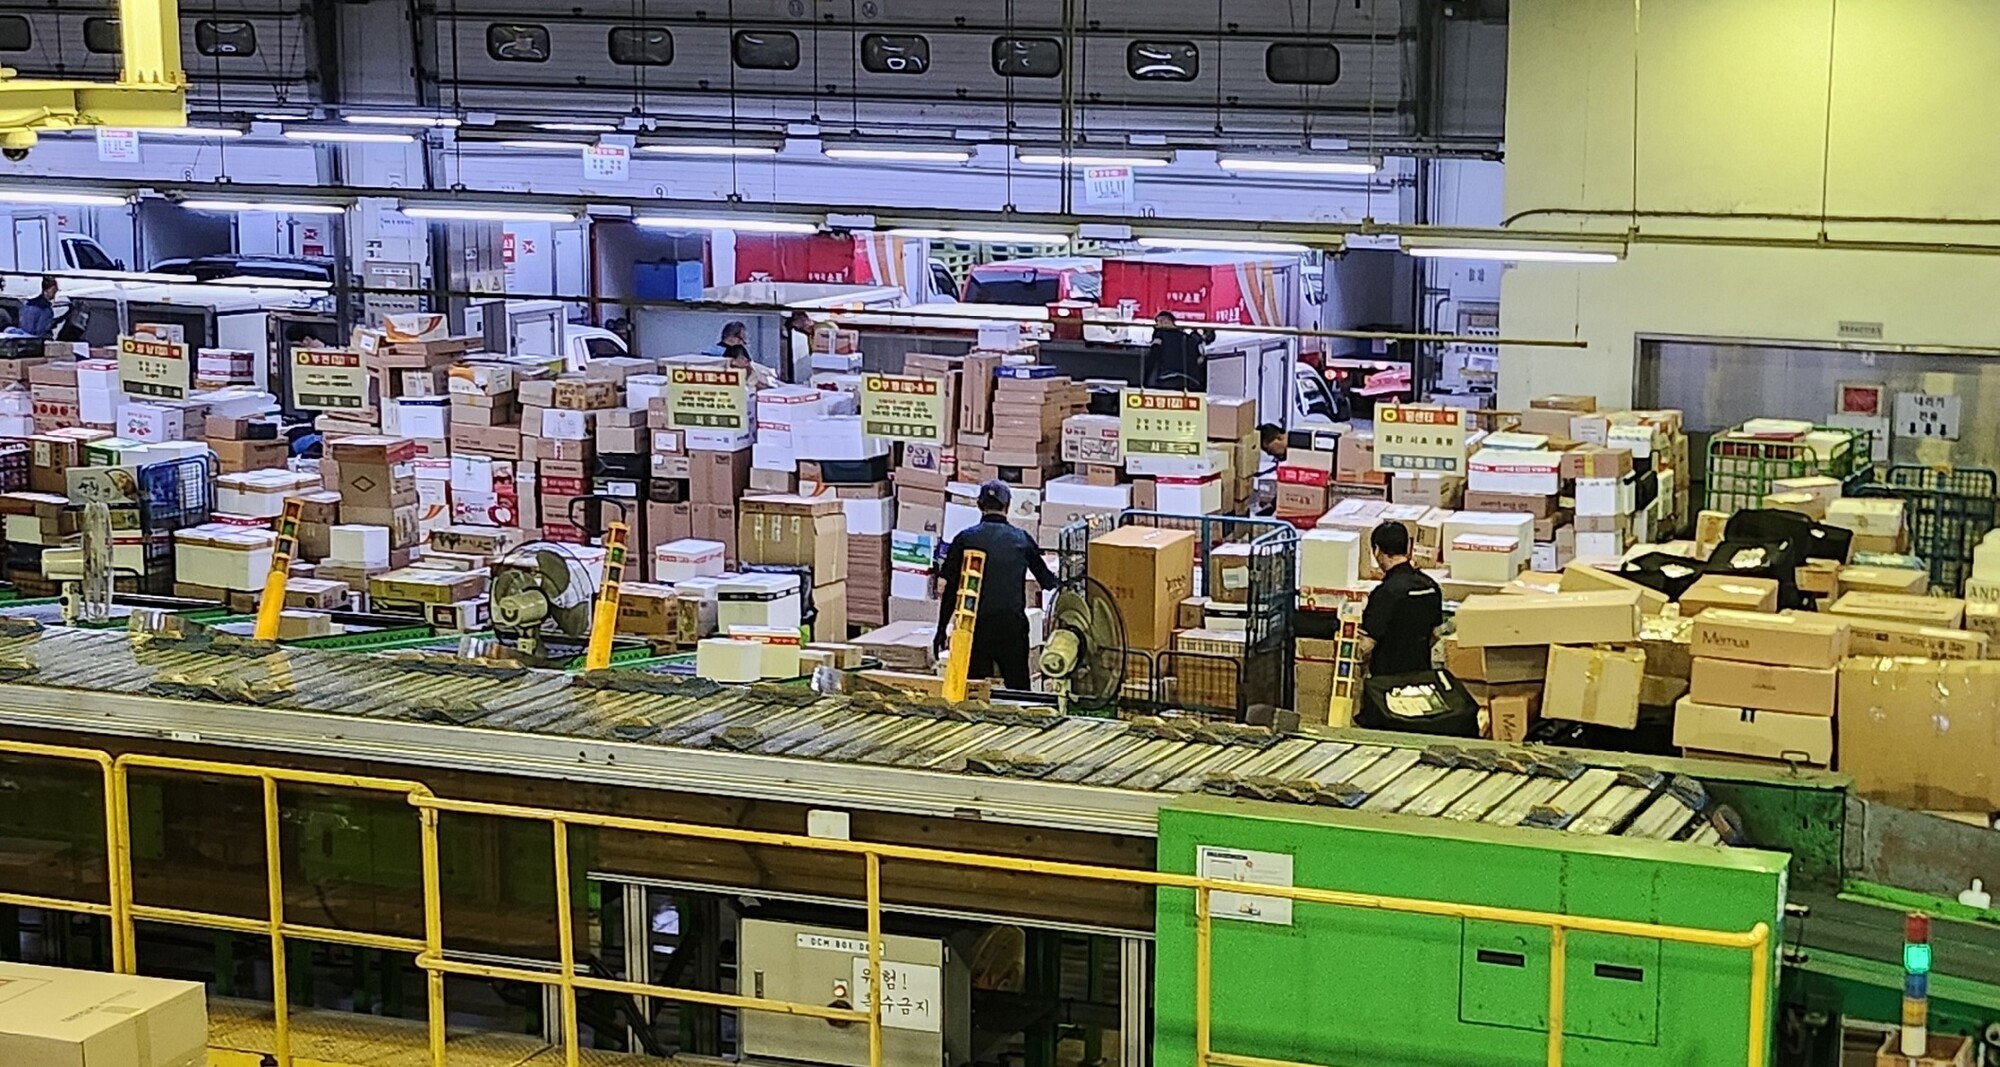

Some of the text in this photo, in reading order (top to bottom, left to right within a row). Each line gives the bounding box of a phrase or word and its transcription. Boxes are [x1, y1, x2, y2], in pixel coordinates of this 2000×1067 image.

[184, 170, 192, 182] 8
[655, 187, 664, 199] 9
[1142, 208, 1156, 219] 10
[1914, 397, 1944, 408] 내리기
[1919, 411, 1937, 422] 전용
